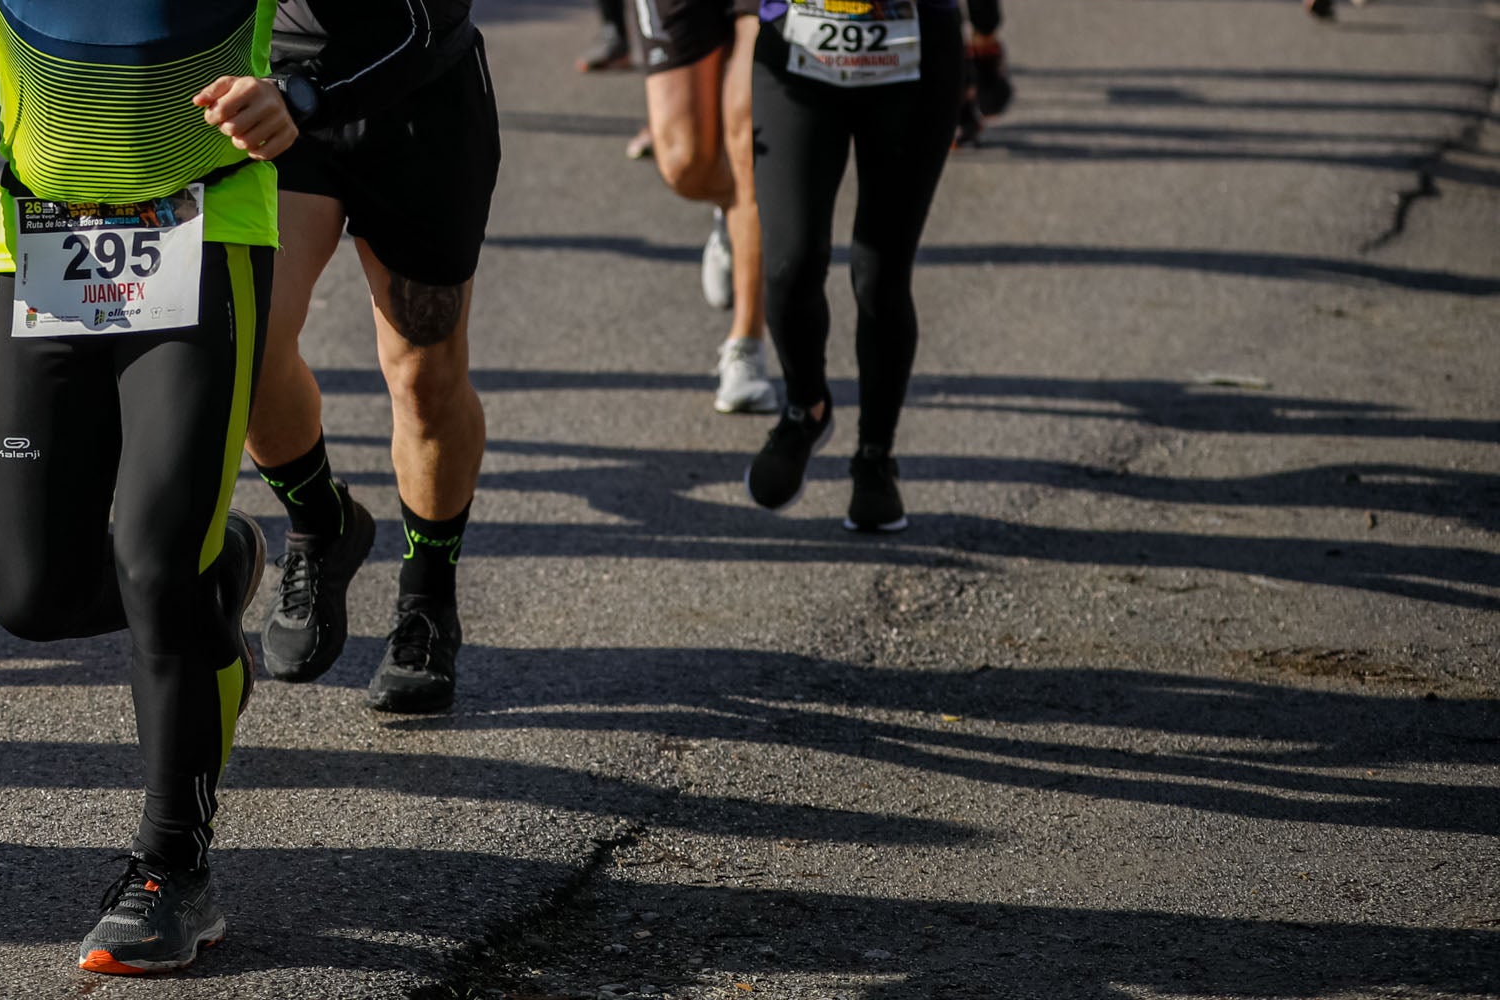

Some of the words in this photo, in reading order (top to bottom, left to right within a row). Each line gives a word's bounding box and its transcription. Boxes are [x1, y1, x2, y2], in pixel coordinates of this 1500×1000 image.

[818, 23, 888, 52] 292
[25, 202, 41, 214] 26
[26, 220, 44, 229] Ruta
[45, 219, 54, 228] de
[62, 232, 161, 281] 295
[82, 282, 145, 304] JUANPEX
[108, 308, 141, 318] olimpo
